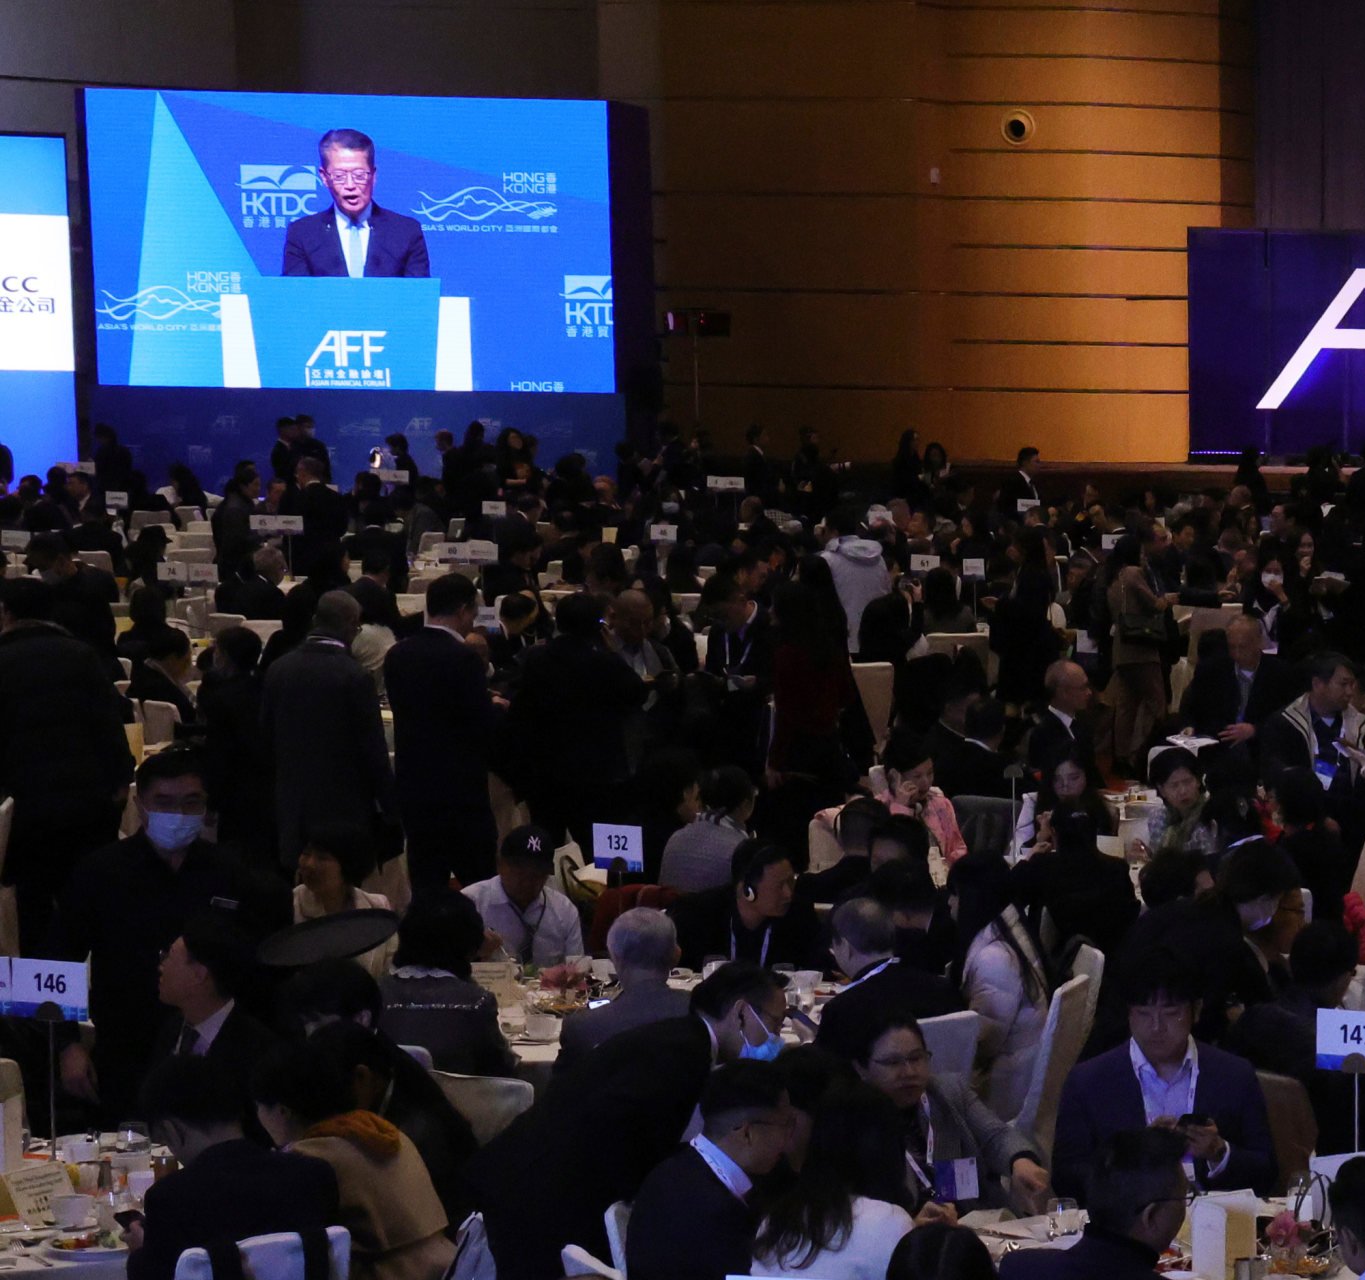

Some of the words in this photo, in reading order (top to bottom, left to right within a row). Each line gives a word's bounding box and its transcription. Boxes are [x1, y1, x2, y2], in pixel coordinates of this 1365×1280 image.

[503, 172, 544, 182] HONG
[503, 184, 544, 194] KONG
[242, 194, 317, 215] HKTDC
[446, 224, 479, 232] WORLD
[187, 271, 229, 282] HONG
[187, 282, 229, 293] KONG
[307, 330, 387, 367] AFF
[511, 382, 552, 392] HONG
[167, 567, 177, 576] 74
[606, 833, 628, 851] 132
[34, 972, 68, 995] 146
